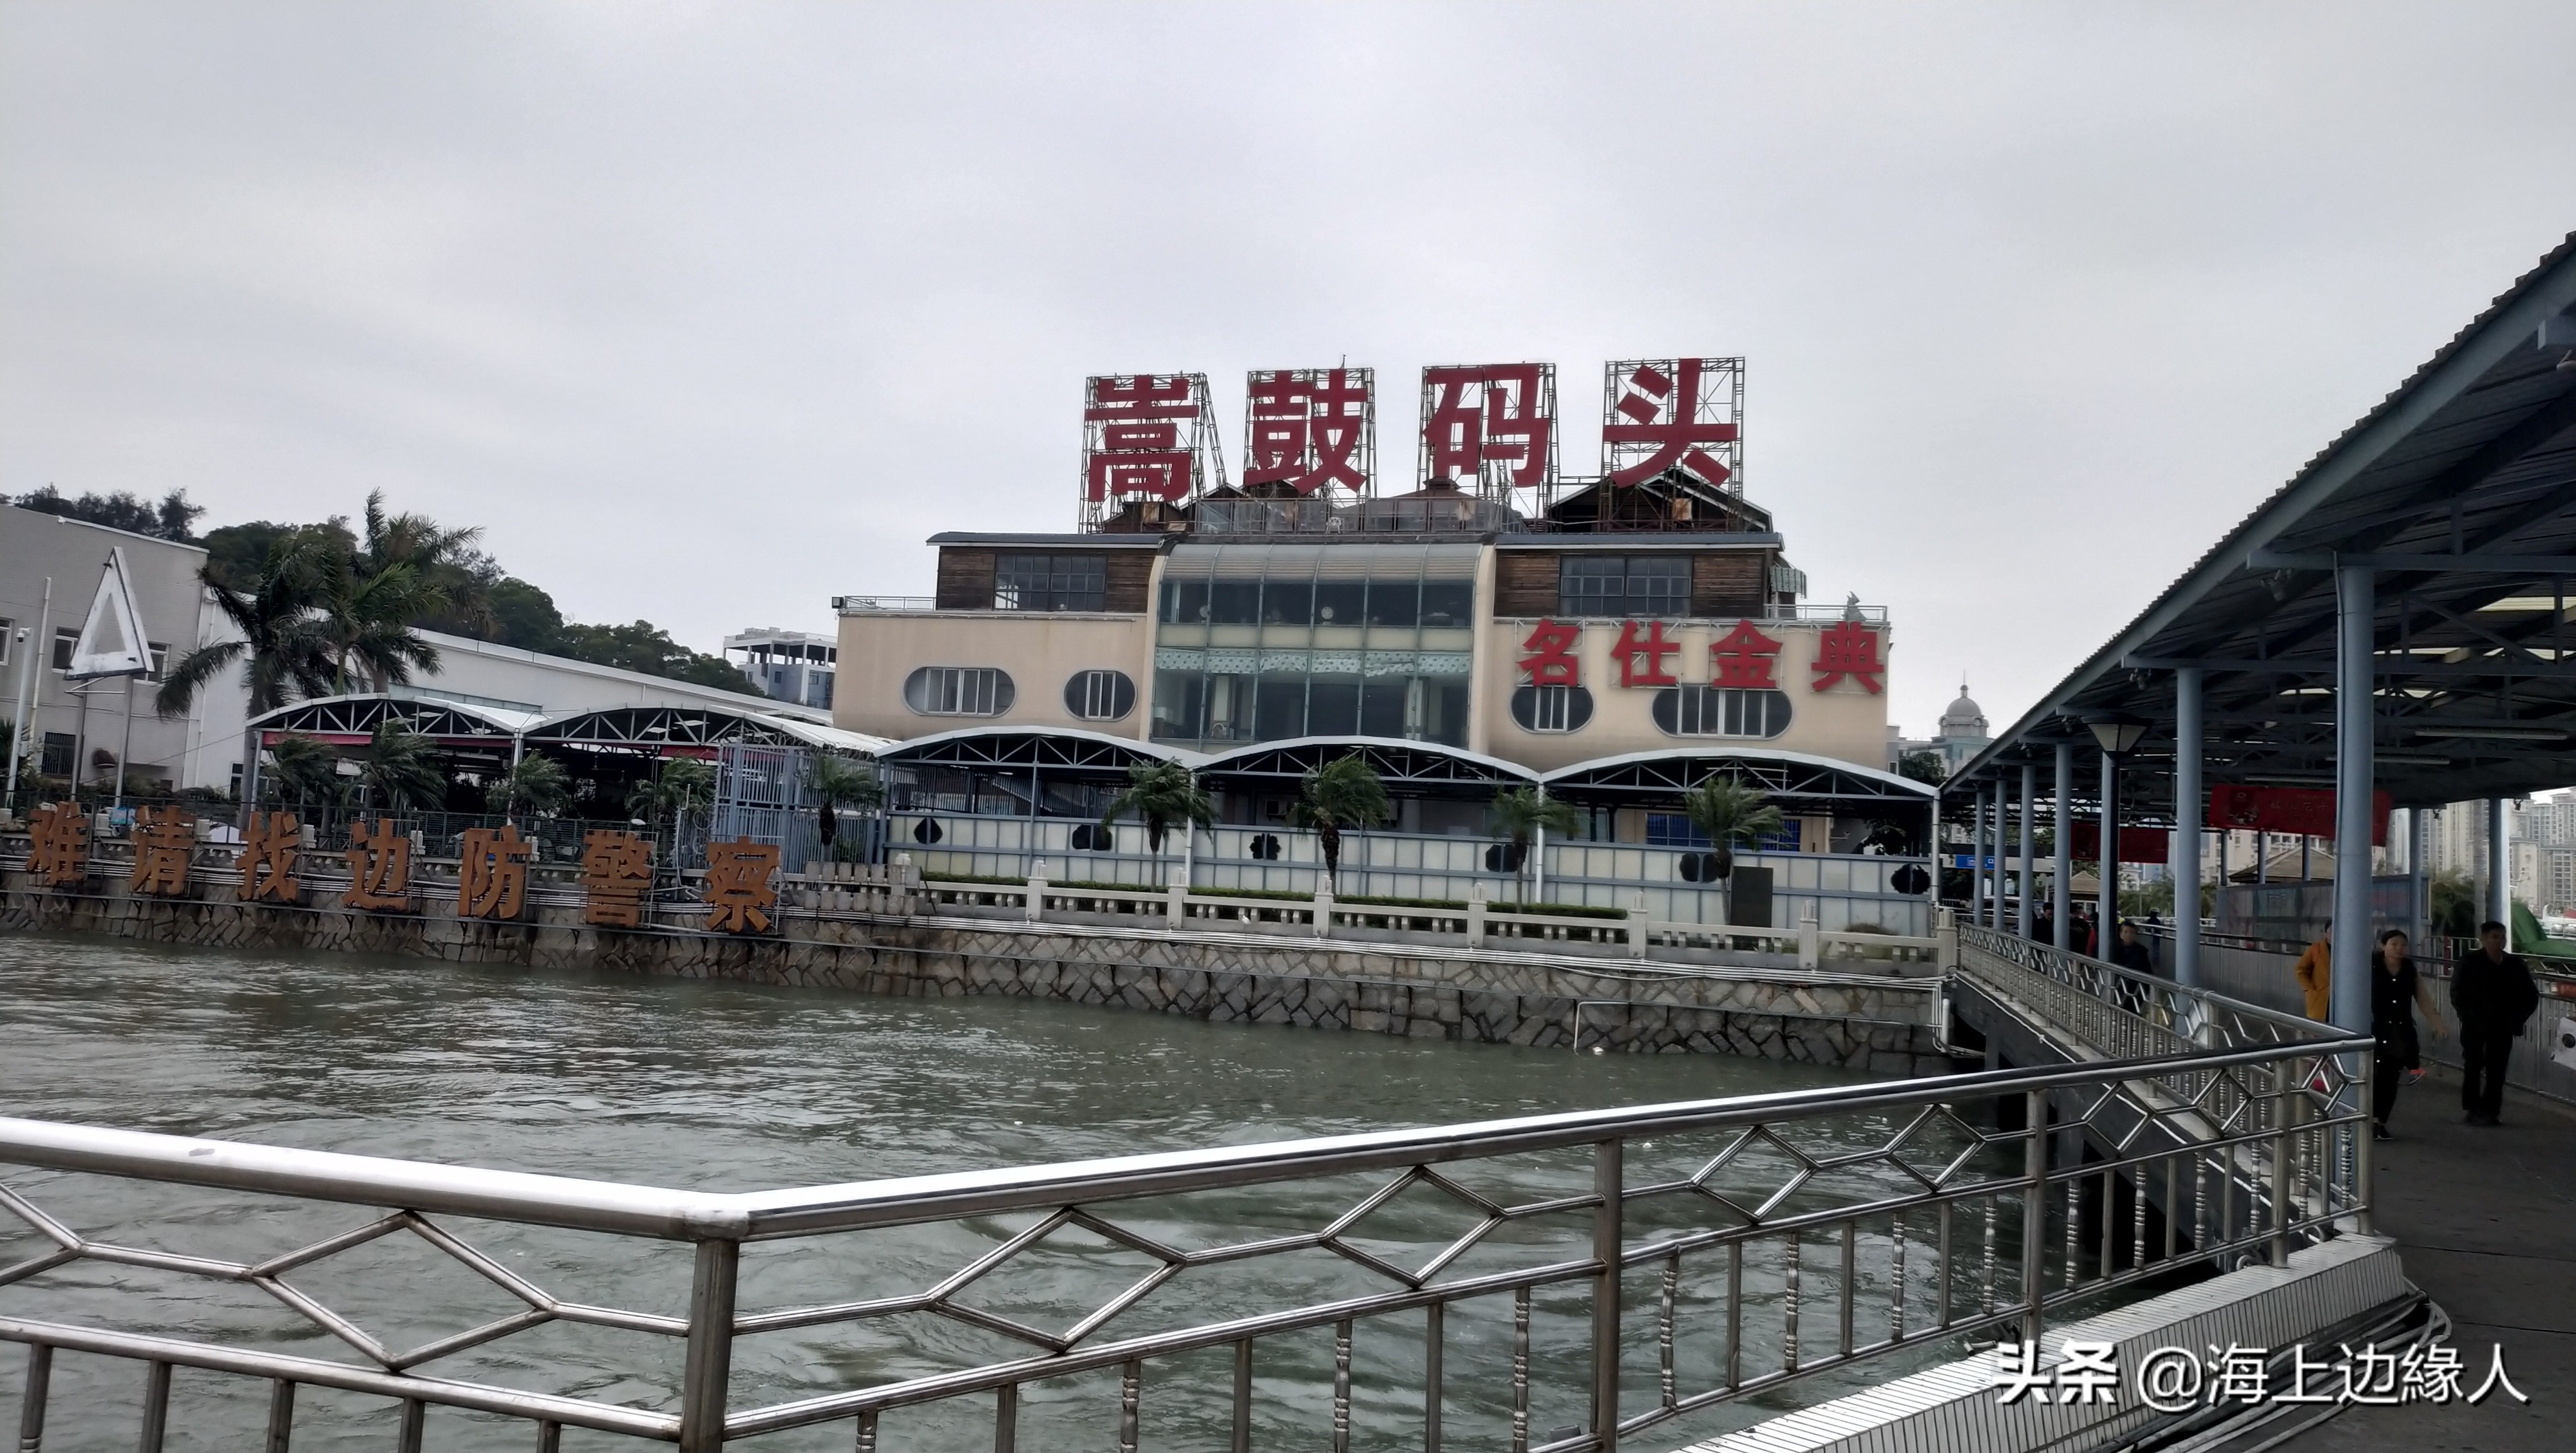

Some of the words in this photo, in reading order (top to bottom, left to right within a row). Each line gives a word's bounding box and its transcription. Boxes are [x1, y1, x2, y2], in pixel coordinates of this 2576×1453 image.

[1084, 358, 1738, 502] 嵩鼓码头
[1517, 619, 1884, 694] 名仕金典
[26, 801, 780, 933] 难请找边防警察
